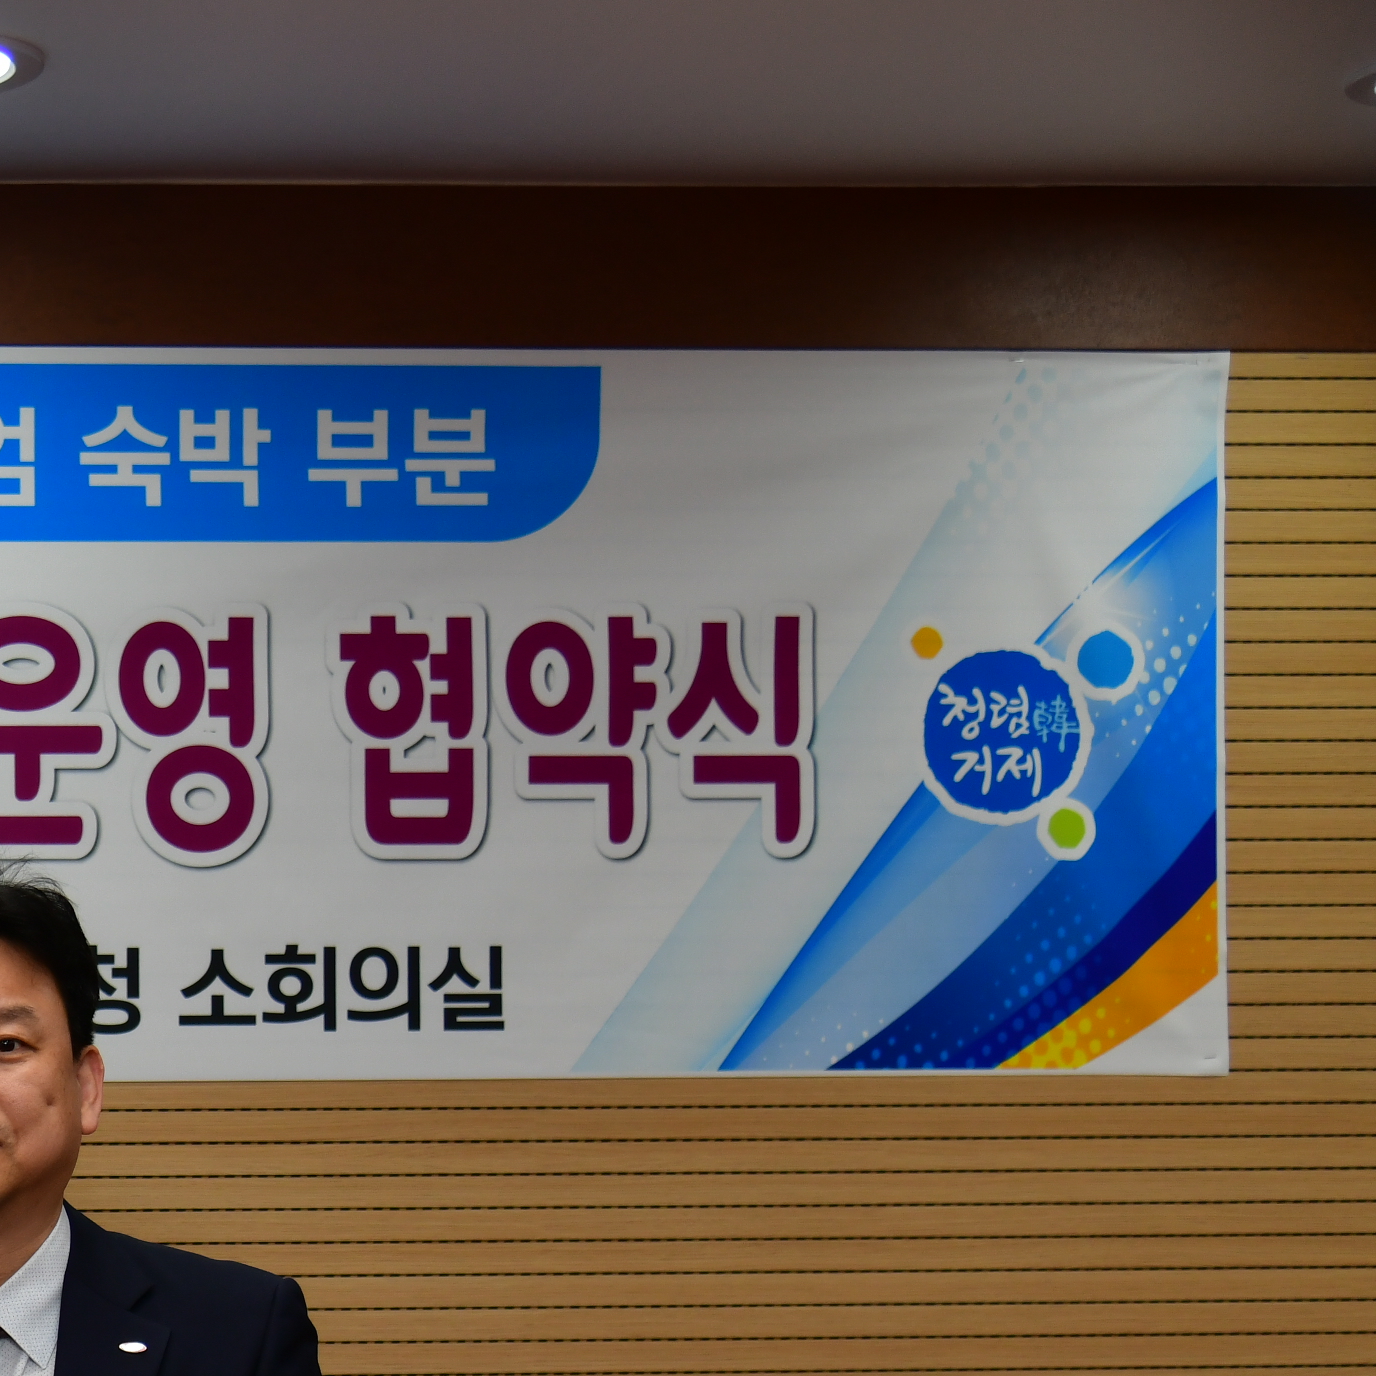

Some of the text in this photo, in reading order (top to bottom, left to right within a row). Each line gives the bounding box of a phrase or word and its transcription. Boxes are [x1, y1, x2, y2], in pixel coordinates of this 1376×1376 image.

[81, 407, 270, 506] 숙박
[309, 408, 495, 506] 부분
[341, 616, 800, 848] 협약식
[950, 744, 1042, 797] 거제
[178, 944, 505, 1032] 소회의실
